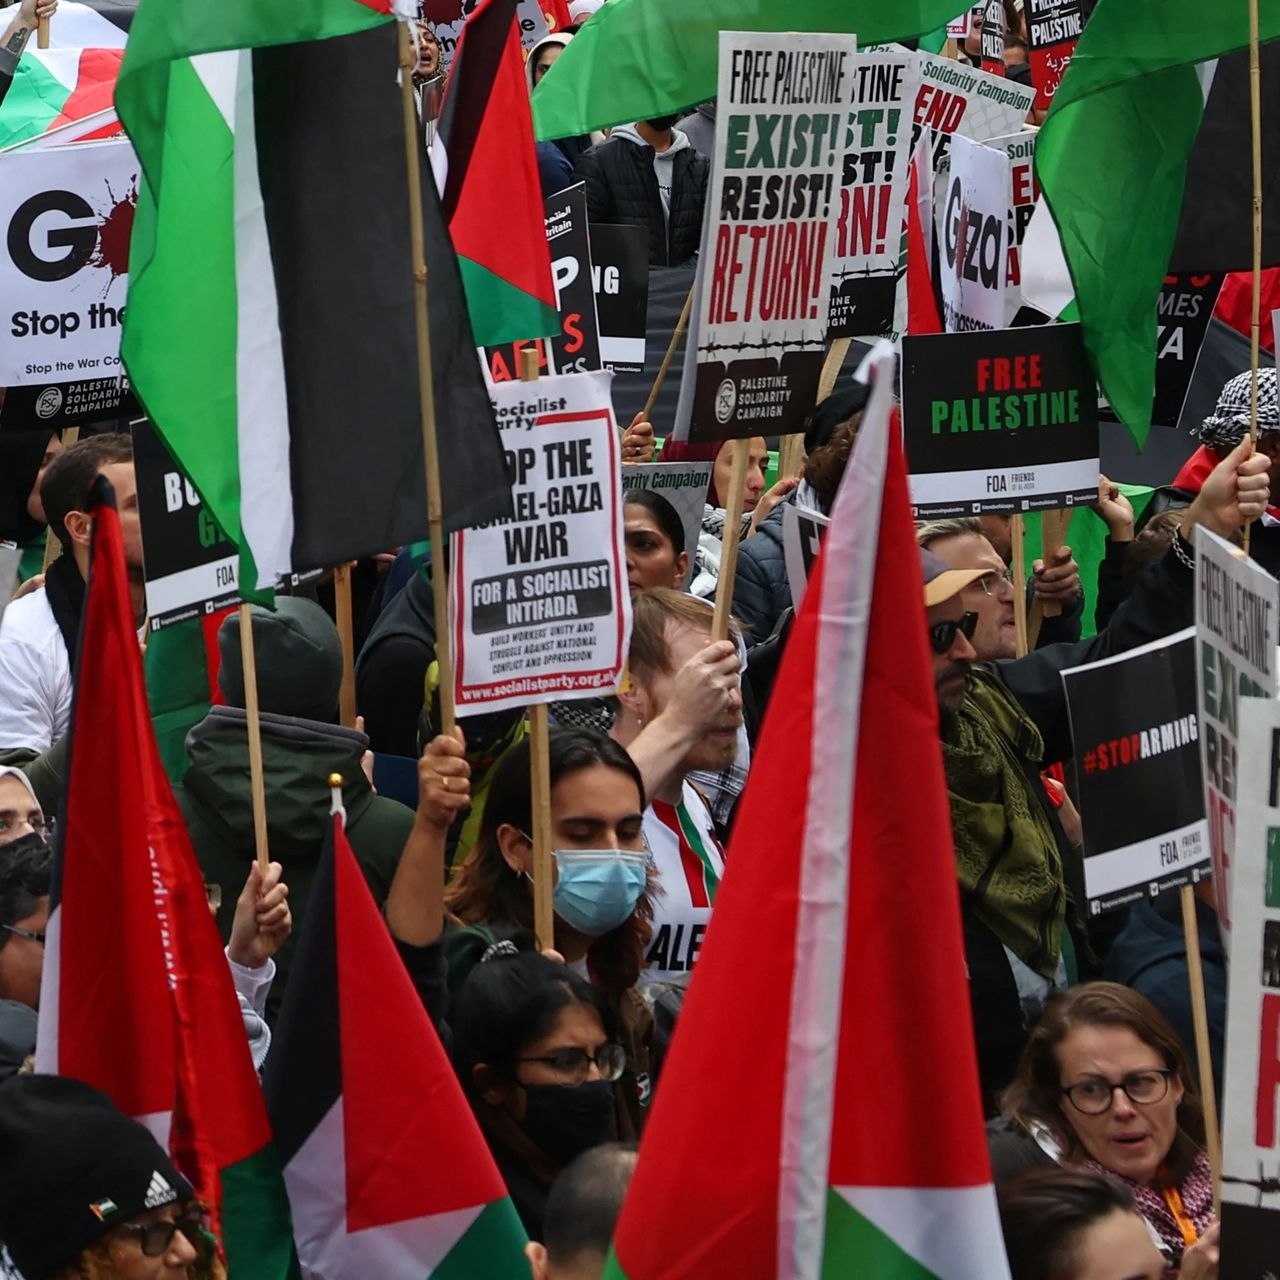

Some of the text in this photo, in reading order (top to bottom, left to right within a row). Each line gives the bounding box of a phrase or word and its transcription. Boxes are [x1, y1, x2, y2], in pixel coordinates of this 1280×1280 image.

[730, 50, 847, 105] FREE PALESTINE
[724, 114, 839, 170] EXIST!
[720, 173, 833, 221] RESIST!
[708, 220, 829, 325] RETURN!
[976, 354, 1043, 393] FREE
[931, 389, 1080, 434] PALESTINE
[504, 521, 569, 565] WAR
[473, 564, 609, 608] FOR A SOCIALIST
[506, 596, 578, 625] INTIFADA
[489, 635, 597, 662] STRUGGLE AGAINST NATIONAL
[490, 632, 510, 648] BUILD
[549, 624, 573, 641] UNITY
[576, 622, 595, 634] AND
[492, 650, 592, 675] CONFLICT AND OPPRESSION
[1084, 713, 1198, 775] #STOPARMING
